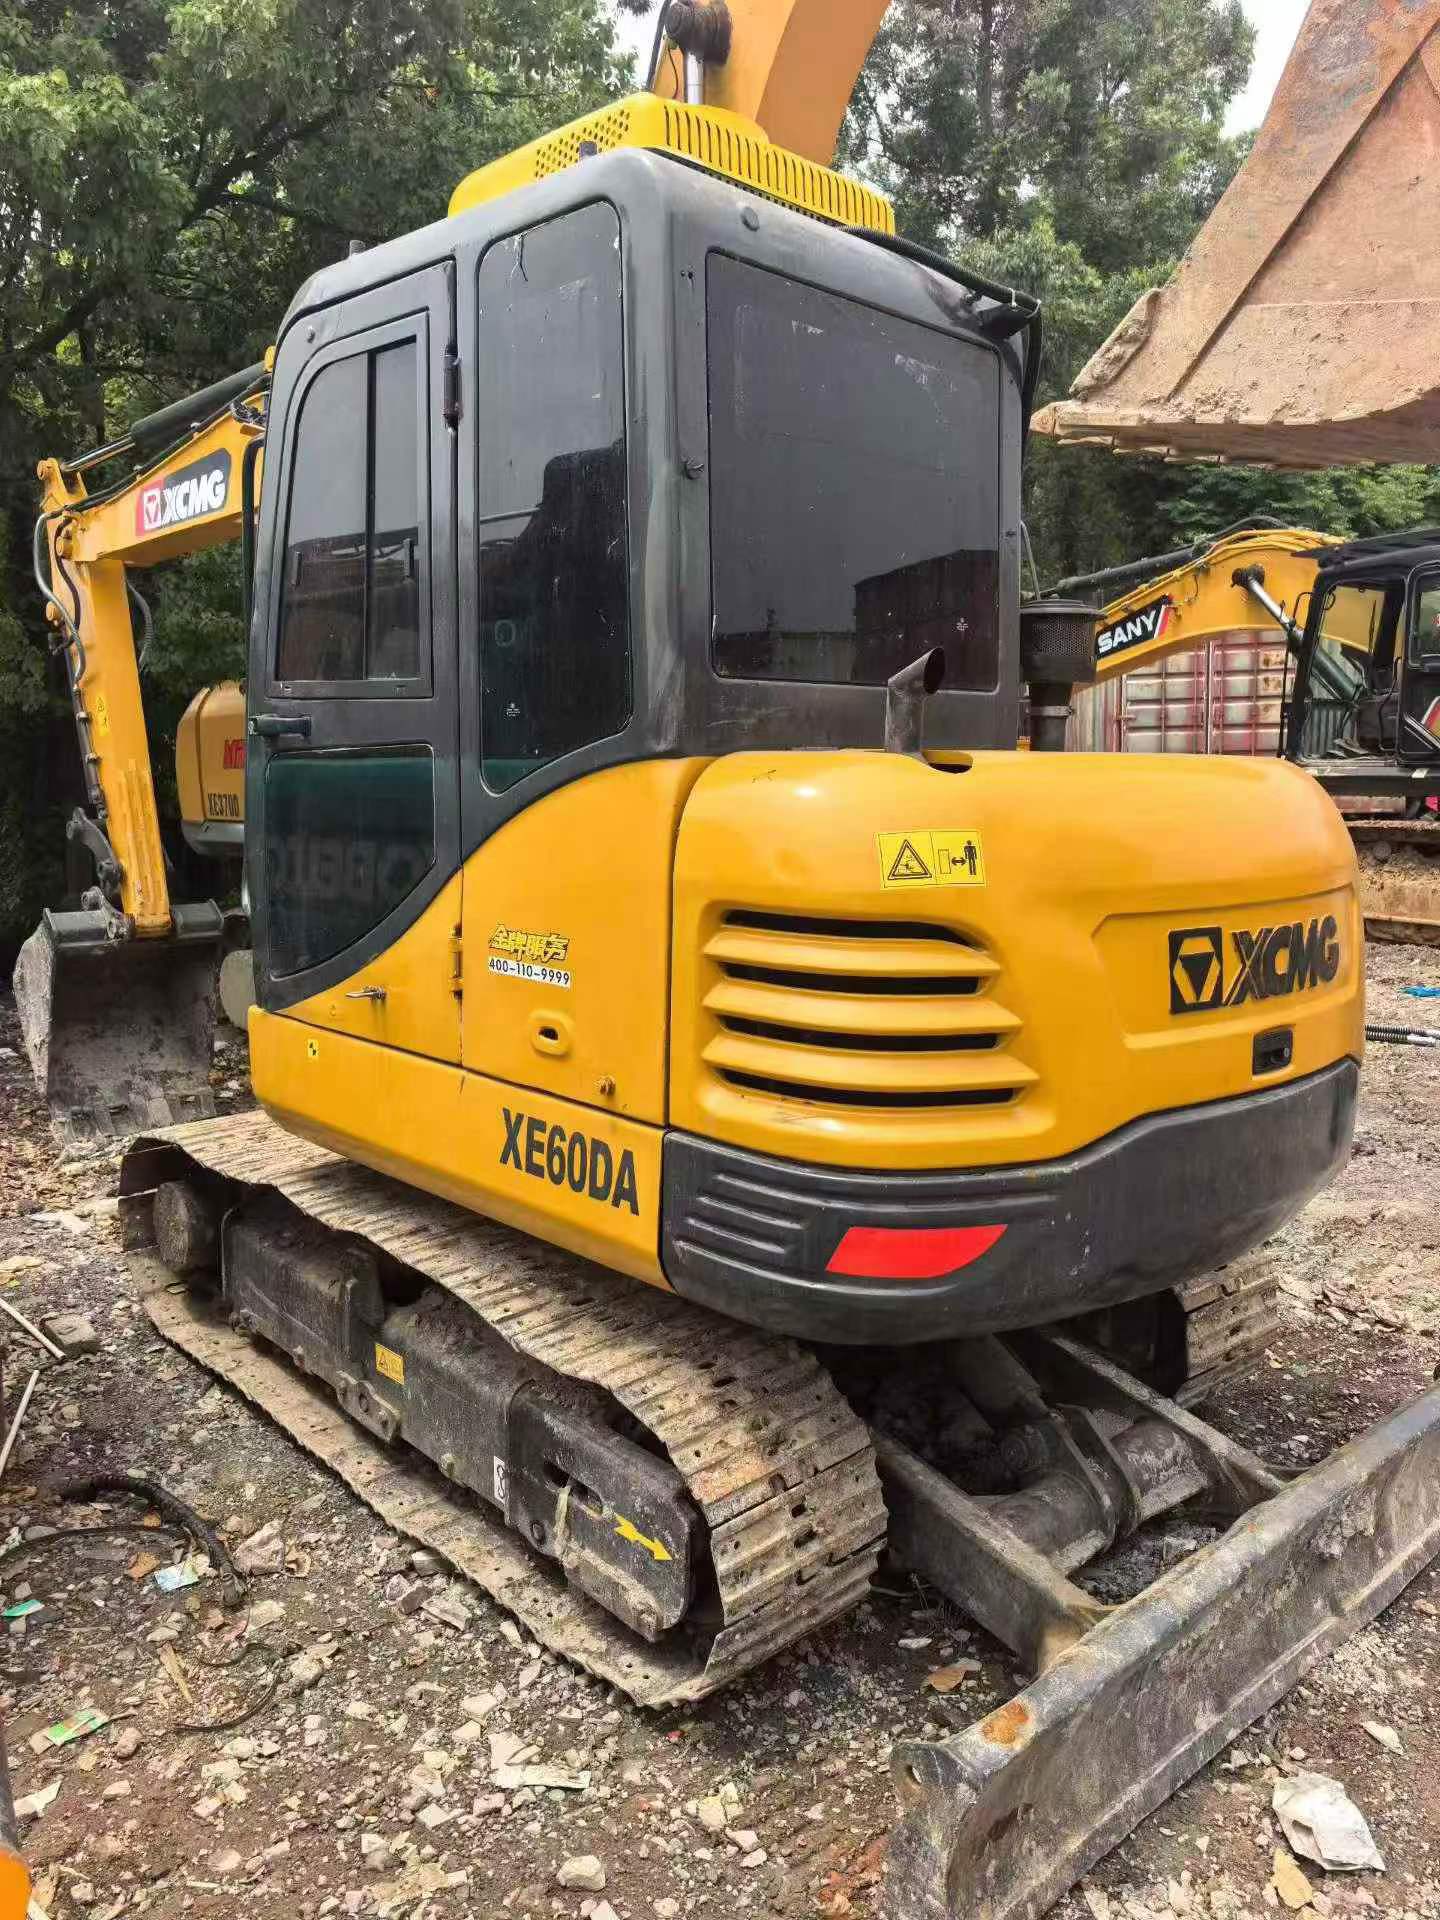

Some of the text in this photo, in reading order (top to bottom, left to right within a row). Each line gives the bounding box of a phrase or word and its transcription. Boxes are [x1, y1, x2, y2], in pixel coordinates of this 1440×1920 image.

[162, 469, 226, 526] XCMG
[1097, 609, 1157, 654] SANY
[489, 958, 570, 985] 400-110-9999
[1223, 915, 1340, 1007] XCMG
[499, 1106, 640, 1217] XE60DA
